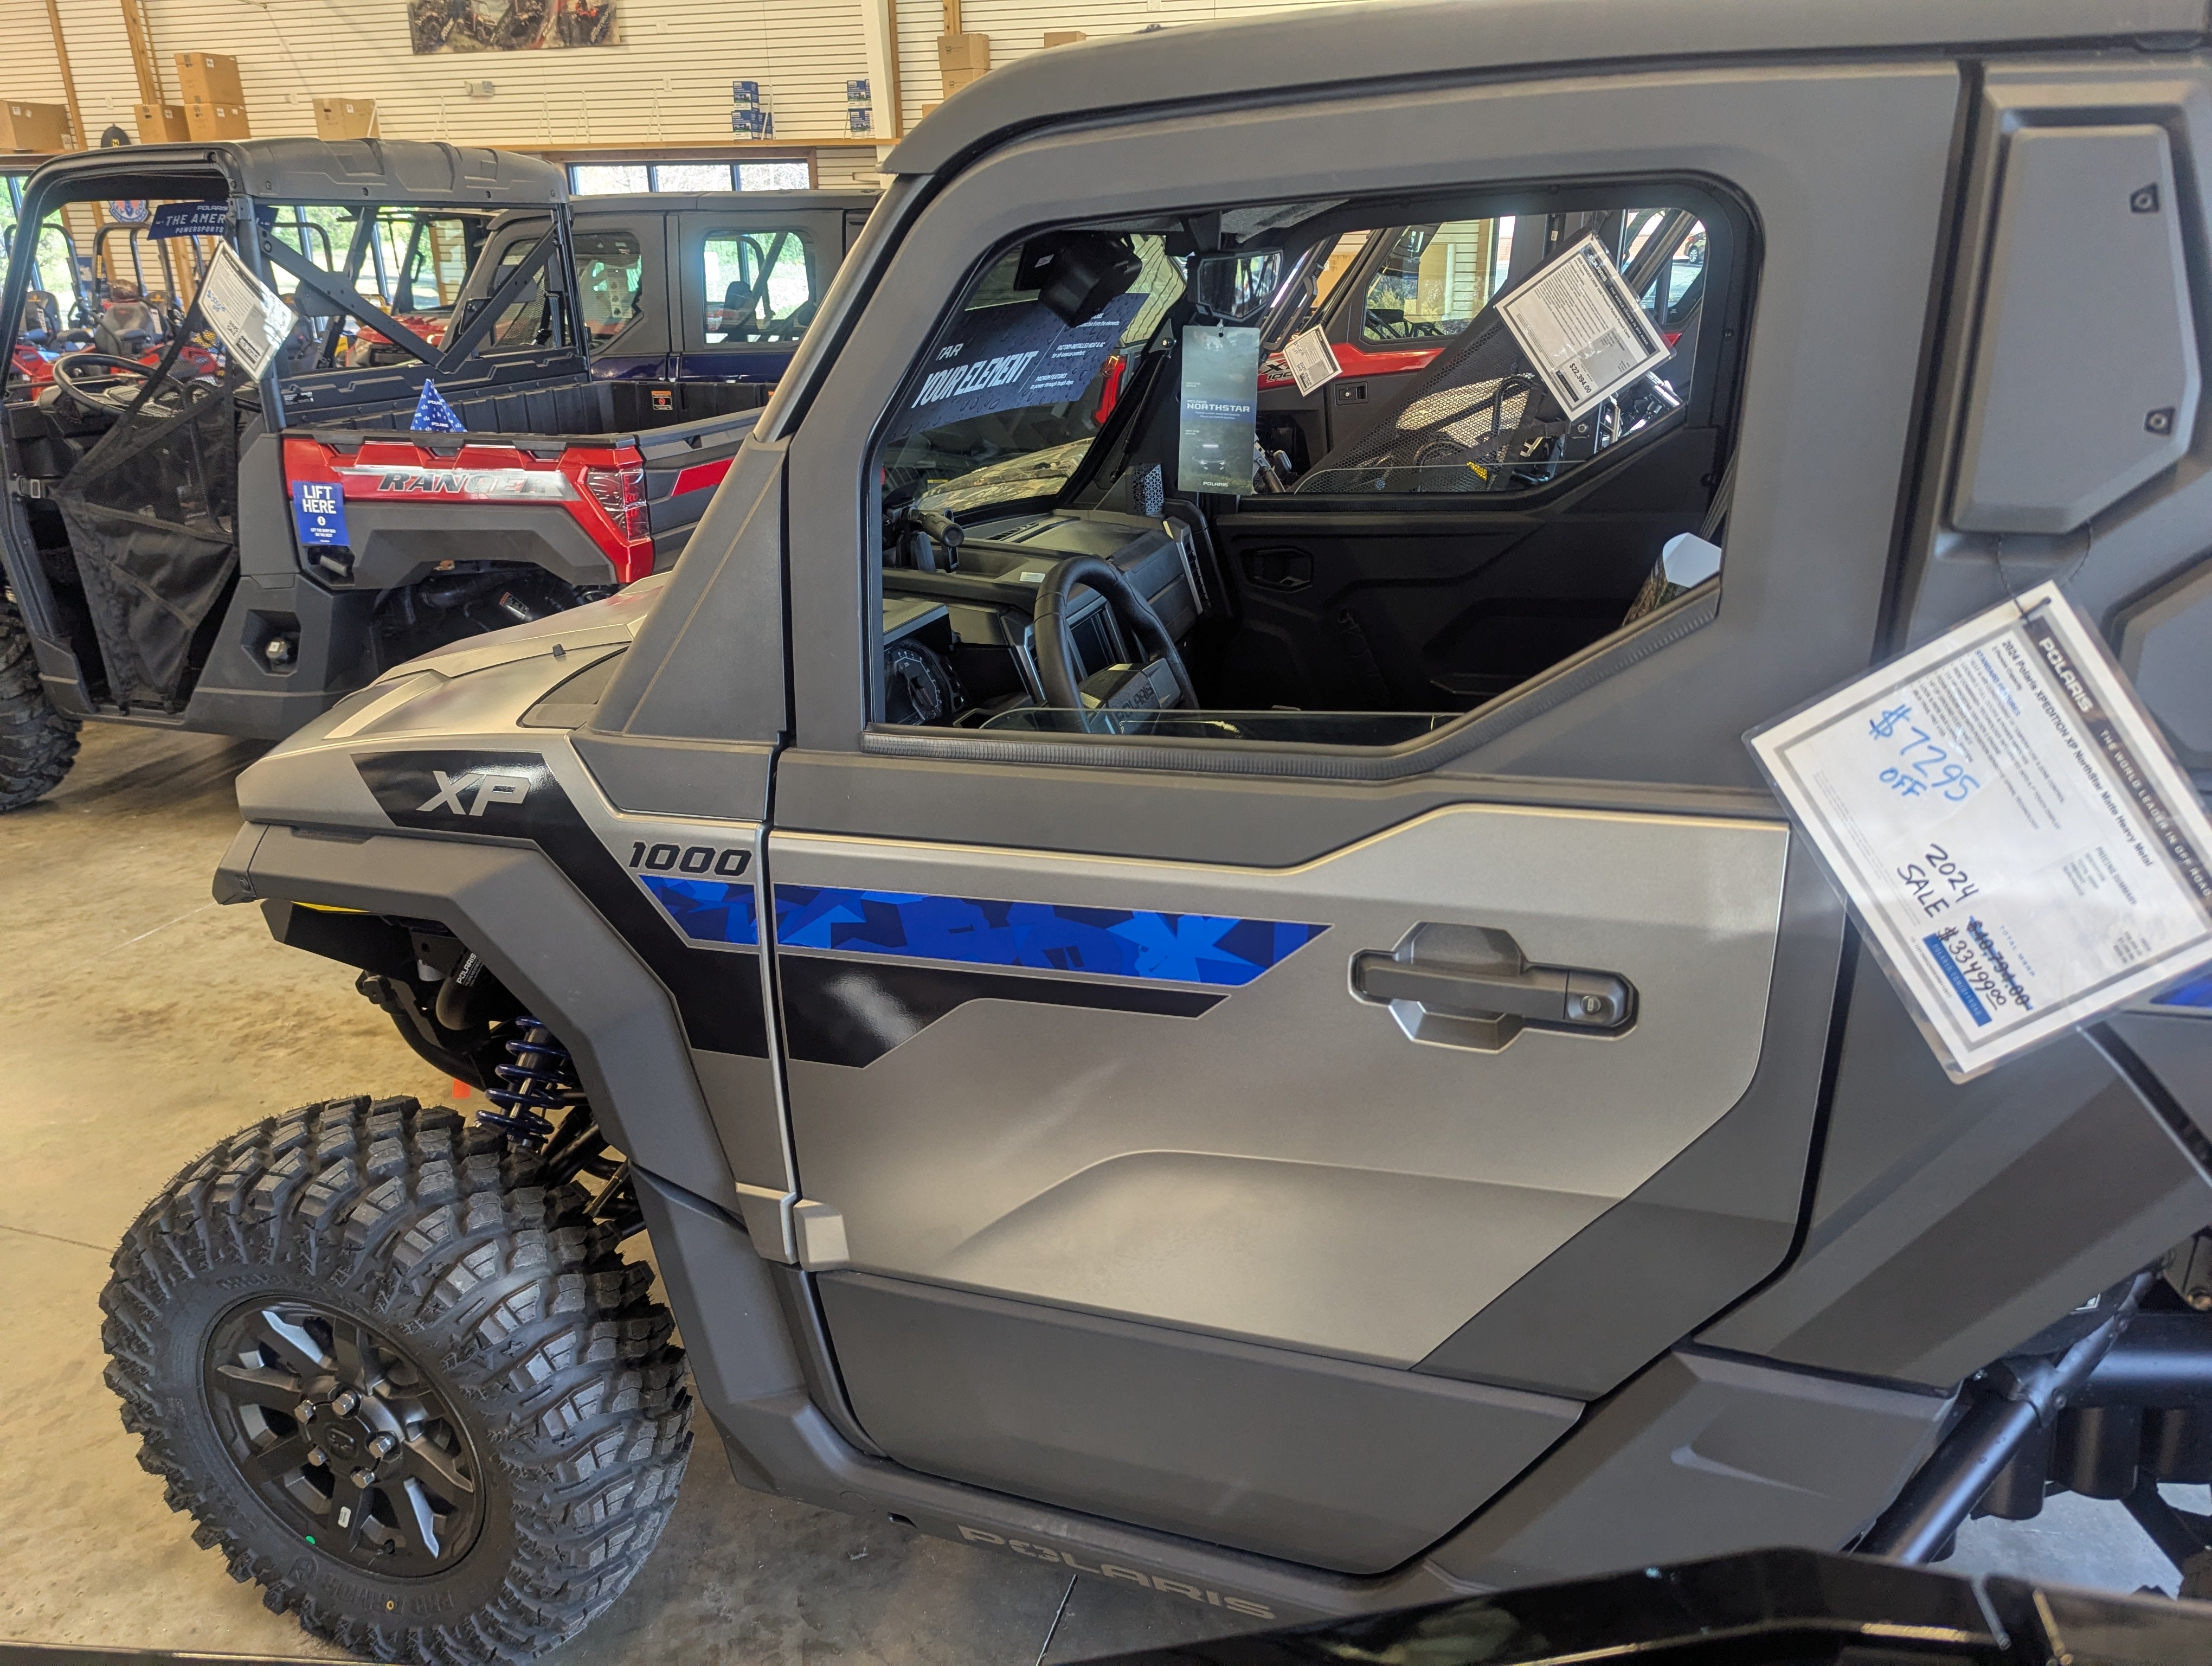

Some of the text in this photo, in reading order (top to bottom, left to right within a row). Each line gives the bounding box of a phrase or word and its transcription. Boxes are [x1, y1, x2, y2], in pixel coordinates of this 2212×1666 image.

[166, 214, 227, 226] THE AMER
[175, 226, 224, 234] POWERSPORTS
[911, 351, 1039, 409] YOUR ELEMENT
[1568, 362, 1592, 394] $22,394.00
[1187, 403, 1250, 412] NORTHSTAR
[303, 485, 332, 499] LIFT
[380, 472, 563, 497] RANGER
[302, 499, 337, 514] HERE
[1973, 648, 2000, 684] STANDARD
[2036, 635, 2095, 714] POLARIS
[1867, 704, 1981, 803] $7295
[1999, 637, 2155, 868] 2024 Polaris XPEDITION XP NorthStar Matte Heavy Metal
[416, 771, 530, 817] XP
[1878, 765, 1928, 799] OFF
[2098, 728, 2118, 752] THE
[2112, 750, 2143, 790] WORLD
[2137, 788, 2169, 831] LEADER
[2163, 829, 2178, 845] IN
[2172, 843, 2193, 868] OFF
[628, 840, 753, 877] 1000
[1922, 843, 1980, 904] 2024
[1896, 862, 1950, 919] SALE
[456, 953, 477, 984] POLARIS
[958, 1525, 1276, 1620] POLARIS
